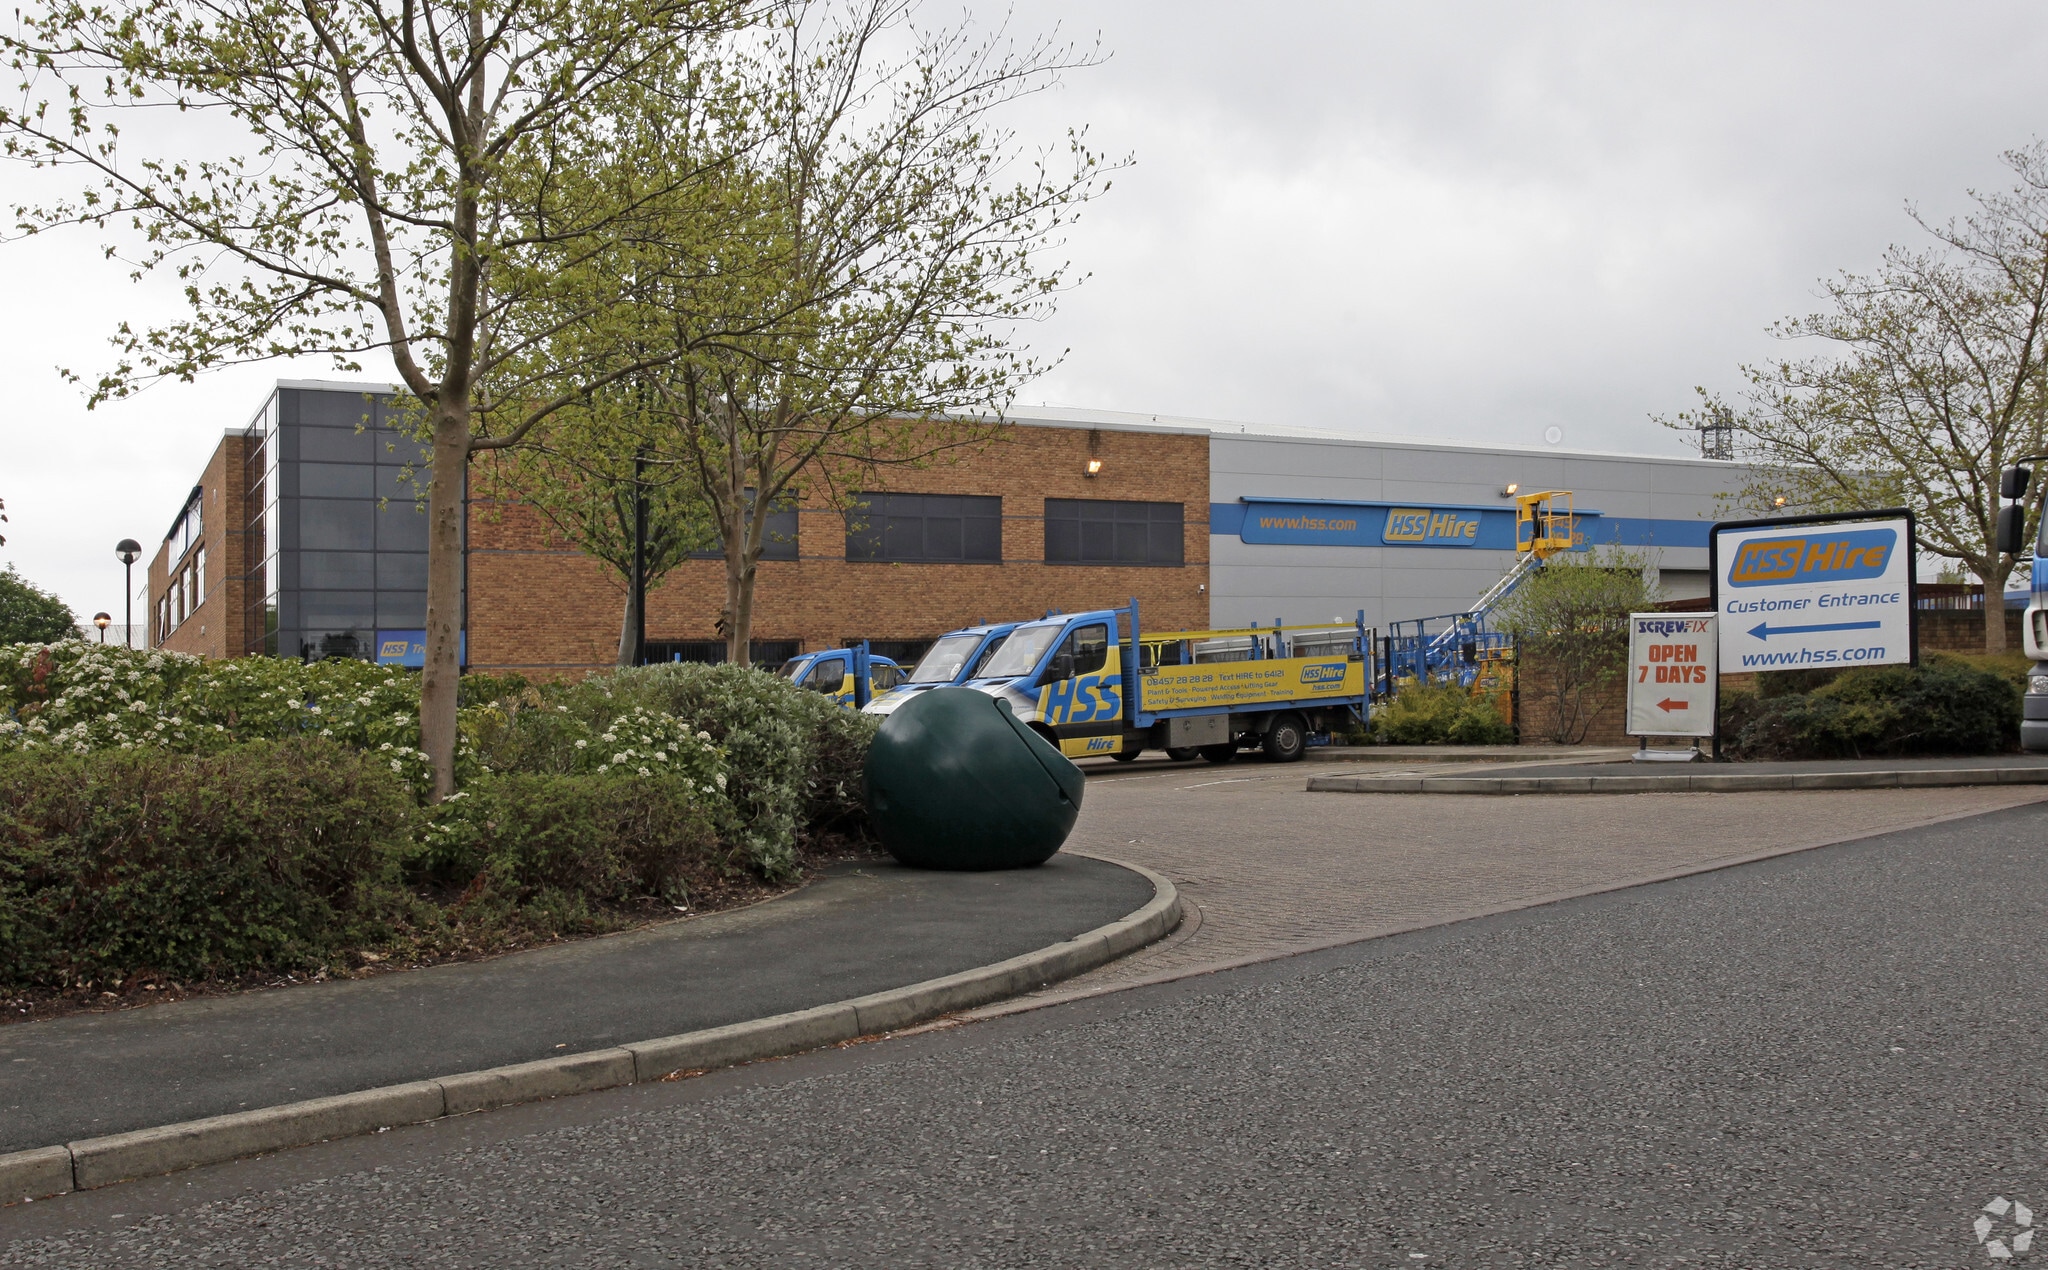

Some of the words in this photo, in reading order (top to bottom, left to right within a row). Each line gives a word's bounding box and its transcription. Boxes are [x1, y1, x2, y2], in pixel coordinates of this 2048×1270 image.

[1259, 515, 1357, 531] www.hss.com
[1390, 514, 1426, 536] HSS
[1428, 513, 1479, 538] Hire
[1740, 545, 1799, 576] HSS
[1802, 541, 1888, 572] Hire
[1726, 597, 1811, 614] Customer
[1818, 592, 1901, 608] Entrance
[383, 643, 405, 655] HSS
[1648, 644, 1697, 663] OPEN
[1742, 646, 1886, 667] www.hss.com
[1147, 677, 1175, 687] 08457
[1176, 676, 1188, 685] 28
[1189, 675, 1201, 684] 28
[1202, 674, 1214, 683] 28
[1219, 673, 1234, 681] Text
[1235, 672, 1254, 680] HIRE
[1255, 671, 1263, 679] to
[1304, 667, 1321, 680] HSS
[1320, 666, 1344, 679] Hire
[1638, 665, 1649, 684] 7
[1655, 665, 1707, 684] DAYS
[1191, 685, 1219, 693] Powered
[1312, 683, 1341, 691] hss.com
[1046, 674, 1122, 724] HSS
[1086, 737, 1115, 751] Hire
